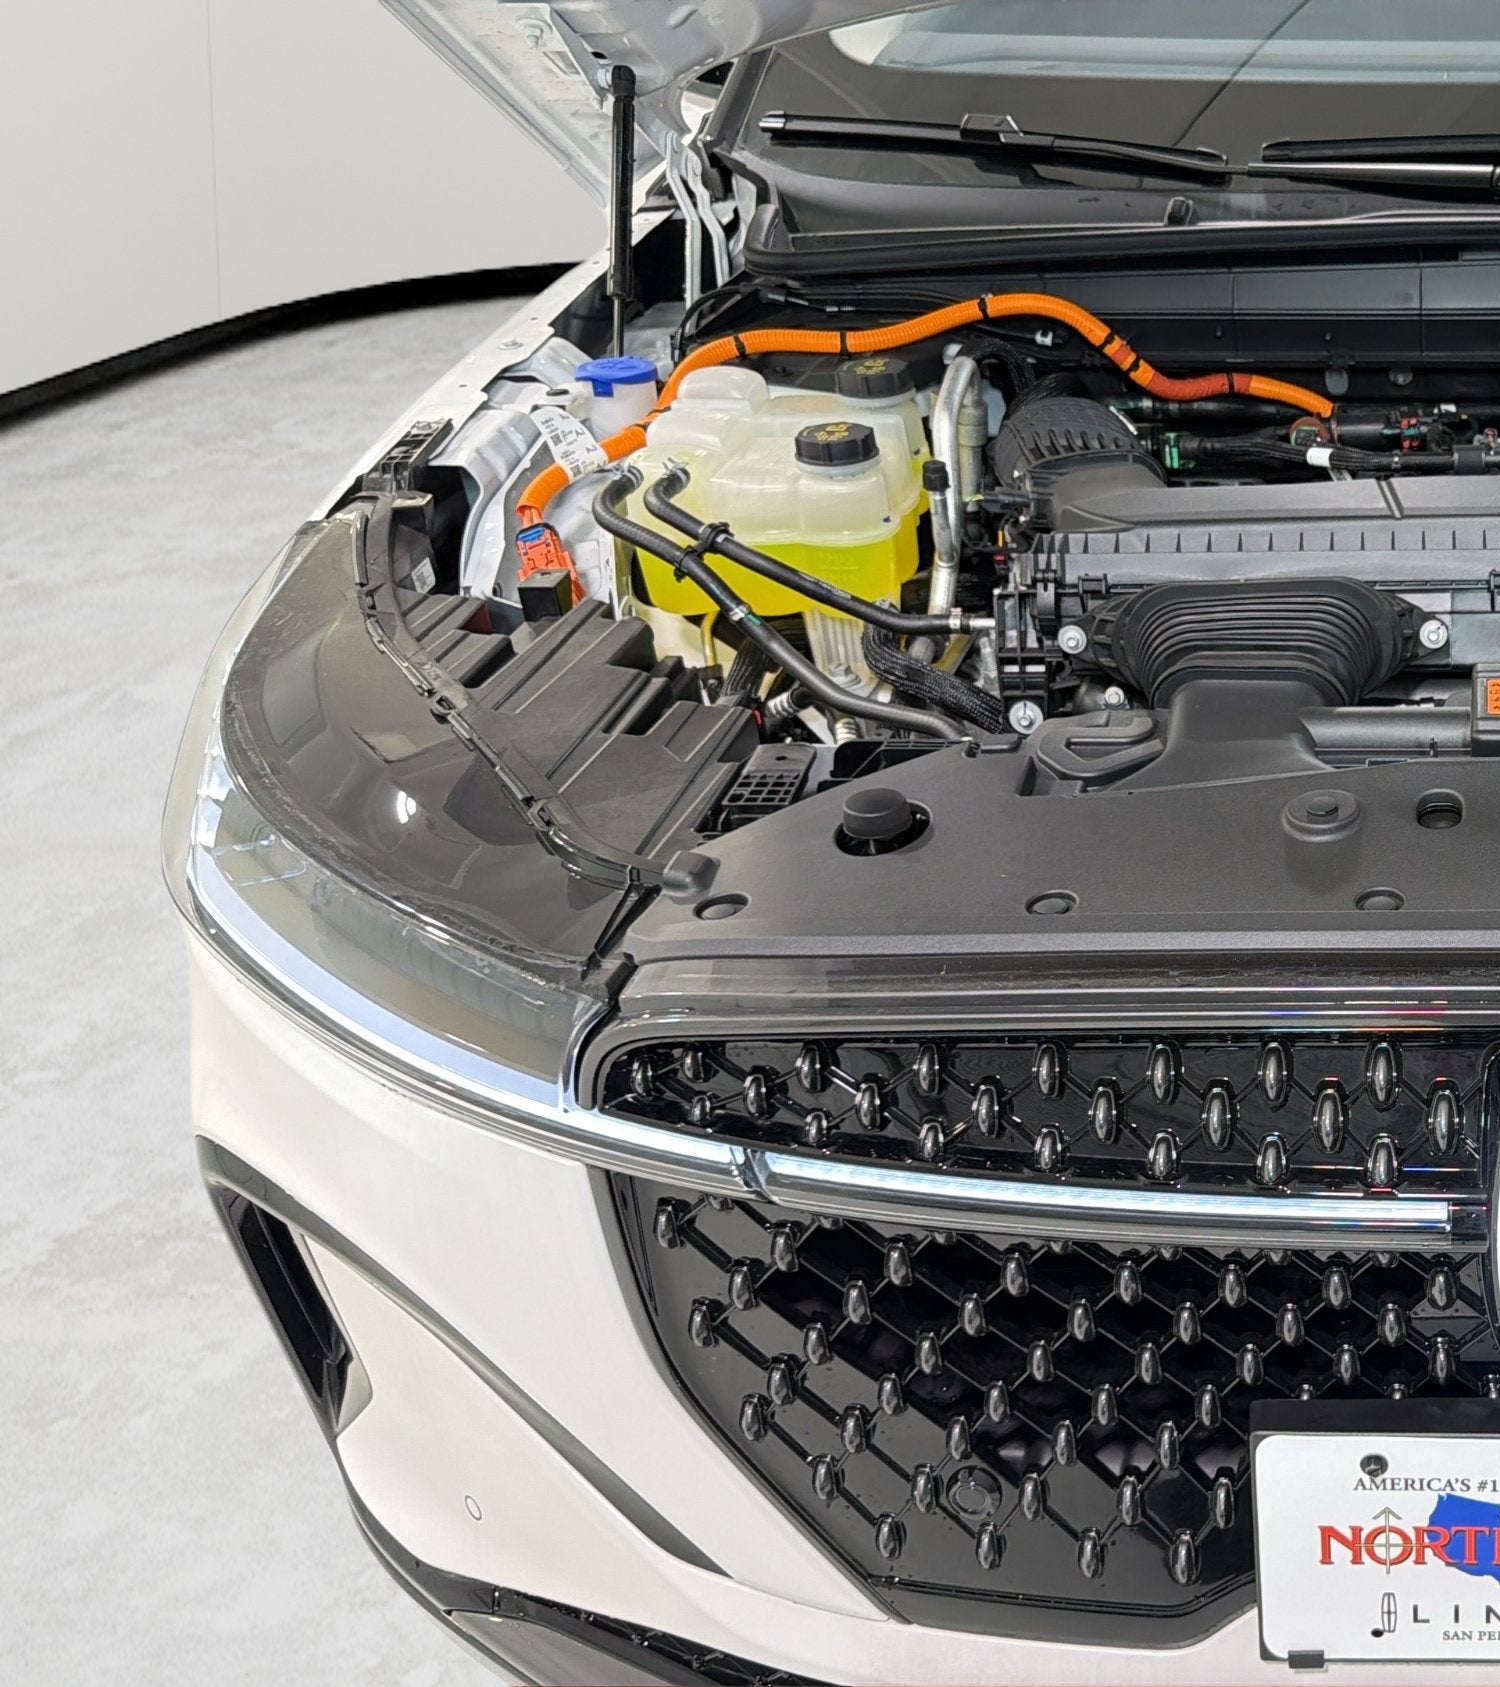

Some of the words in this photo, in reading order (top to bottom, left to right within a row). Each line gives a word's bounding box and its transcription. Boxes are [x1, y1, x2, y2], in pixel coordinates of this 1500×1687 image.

[1353, 1476, 1471, 1492] AMERICA'S
[1477, 1478, 1499, 1493] #1
[1442, 1630, 1474, 1642] SAN
